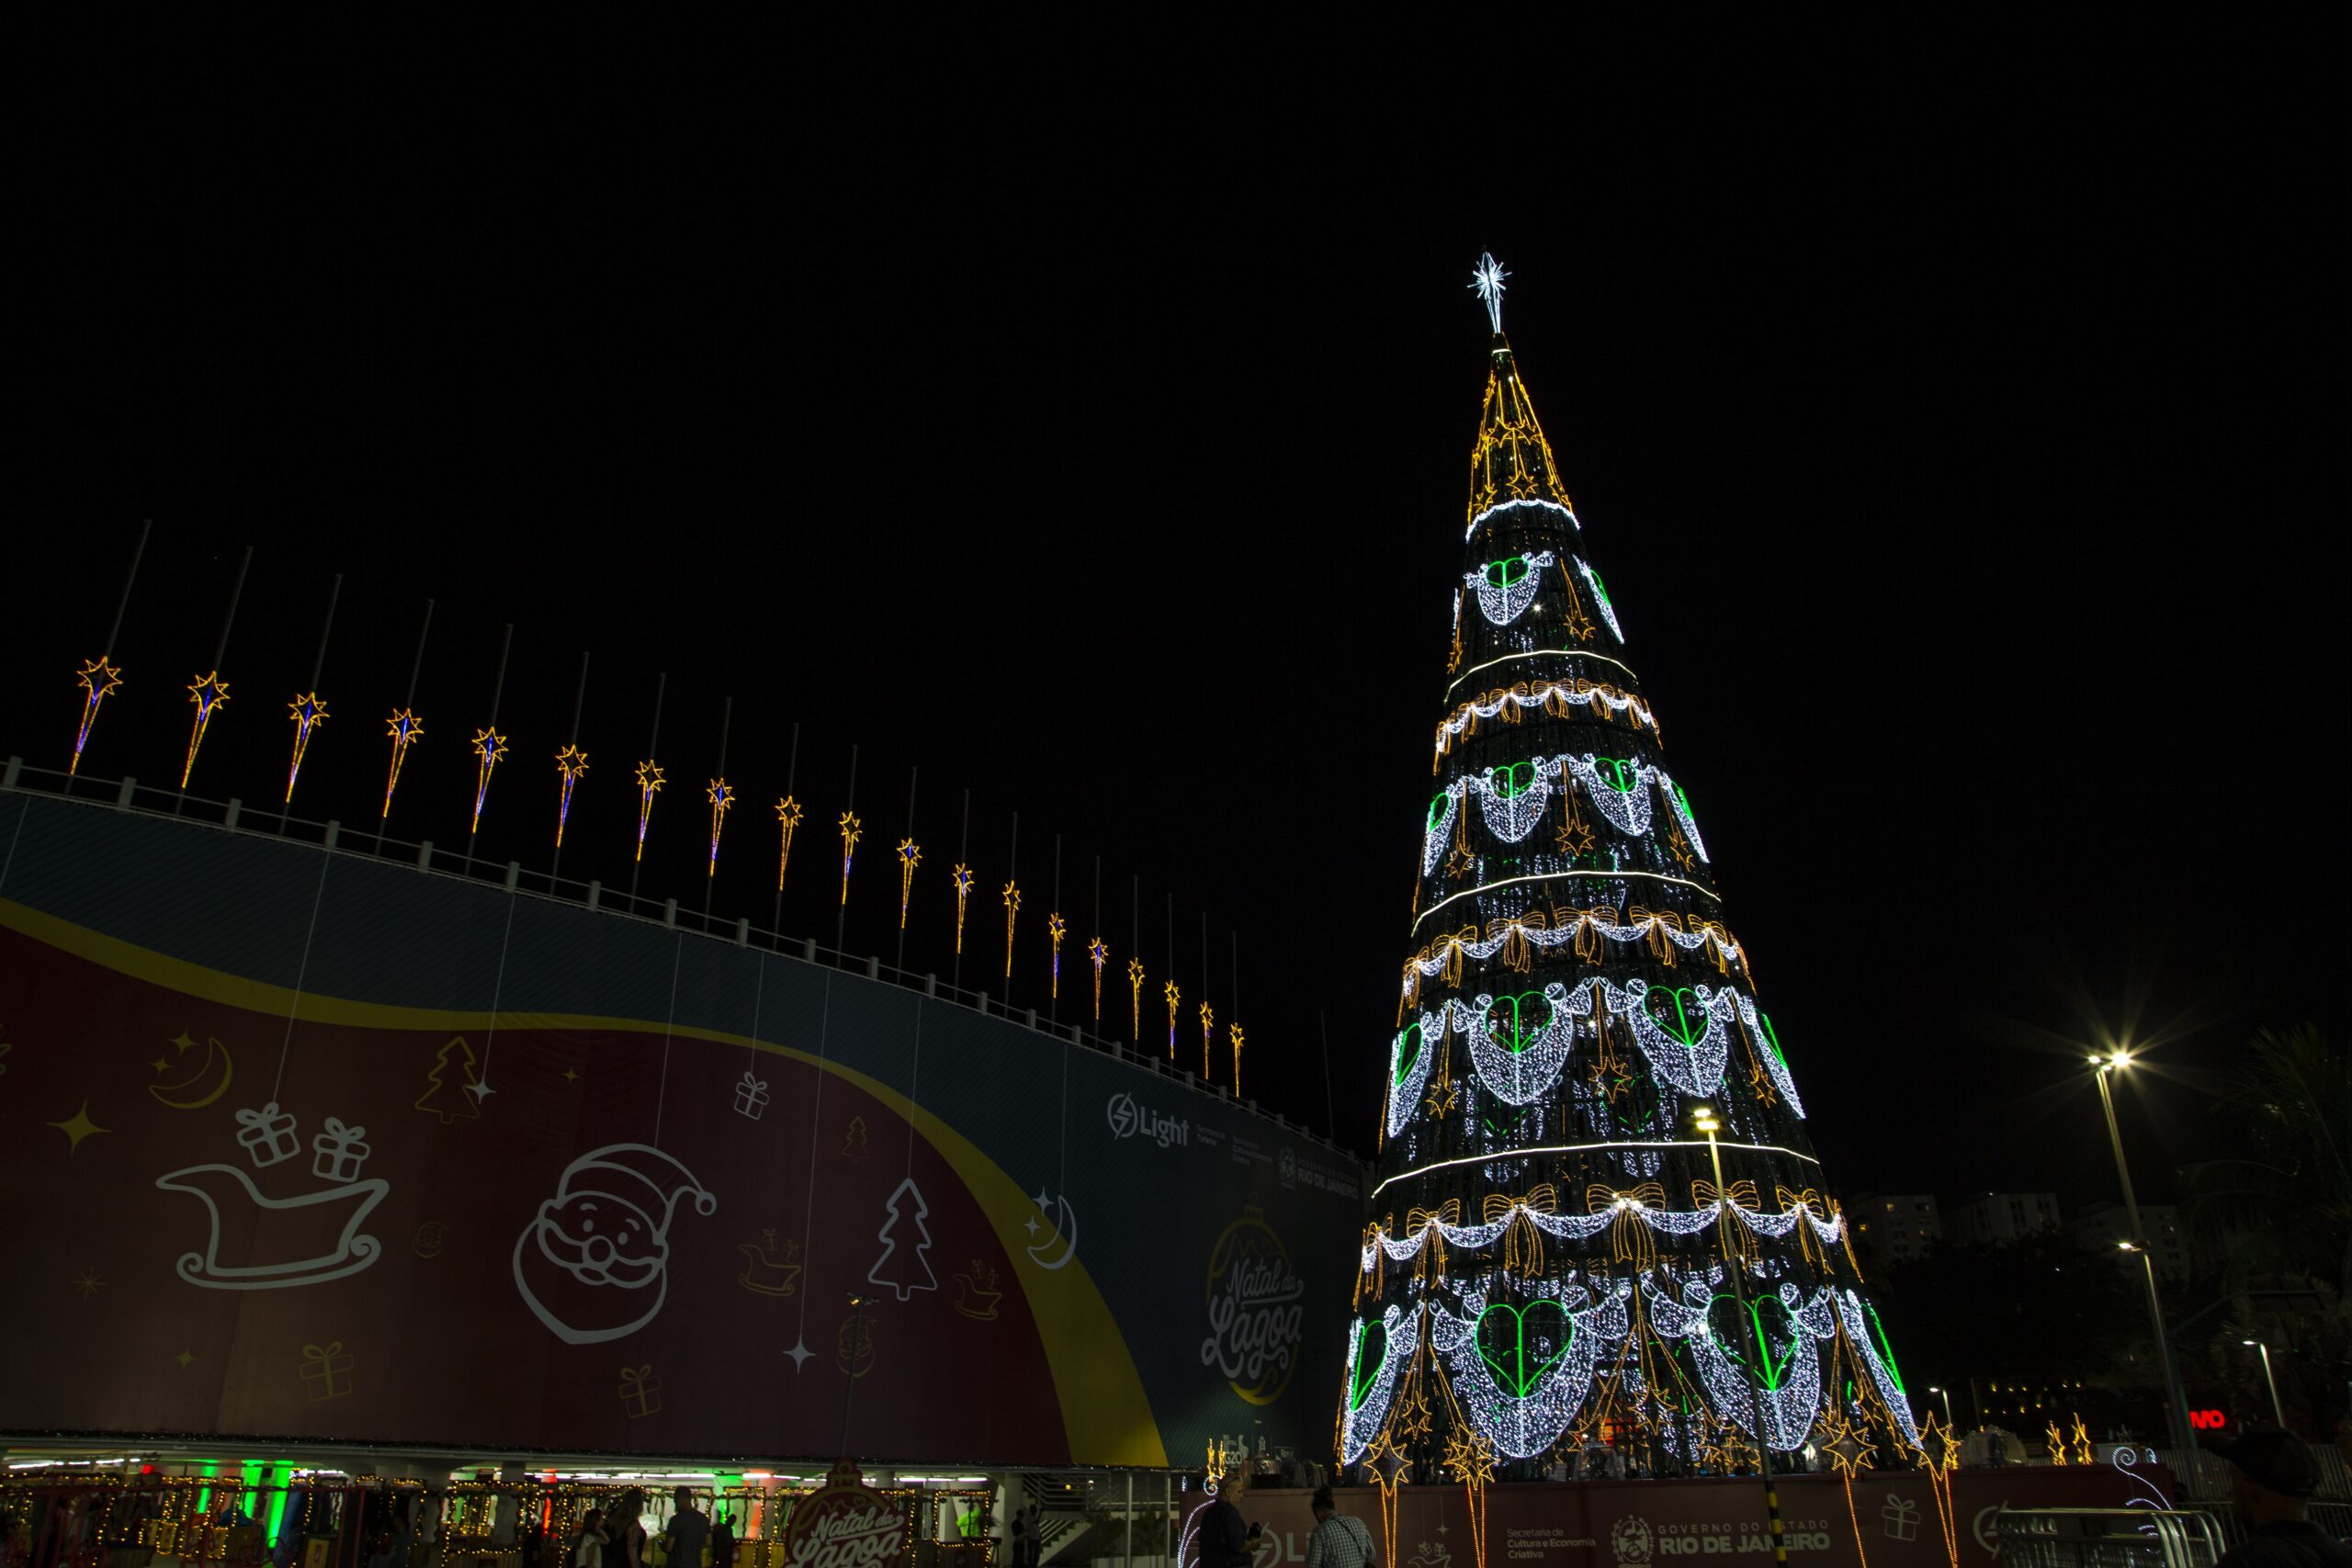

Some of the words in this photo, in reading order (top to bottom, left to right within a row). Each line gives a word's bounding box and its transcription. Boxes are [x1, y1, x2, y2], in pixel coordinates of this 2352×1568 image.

[1140, 1106, 1190, 1148] Light
[1226, 1258, 1282, 1303] Natal
[1282, 1264, 1295, 1292] da
[1201, 1294, 1303, 1380] Lagoa
[810, 1506, 876, 1542] Natal
[875, 1507, 896, 1528] da
[1507, 1529, 1552, 1538] Secretaria
[1552, 1528, 1564, 1537] de
[1657, 1523, 1732, 1534] GOVERNO
[1740, 1522, 1760, 1532] DO
[1507, 1540, 1542, 1548] Cultura
[1542, 1540, 1549, 1548] e
[1549, 1538, 1596, 1547] Economia
[1659, 1537, 1699, 1555] RIO
[1702, 1535, 1733, 1554] DE
[1508, 1551, 1544, 1559] Criativa
